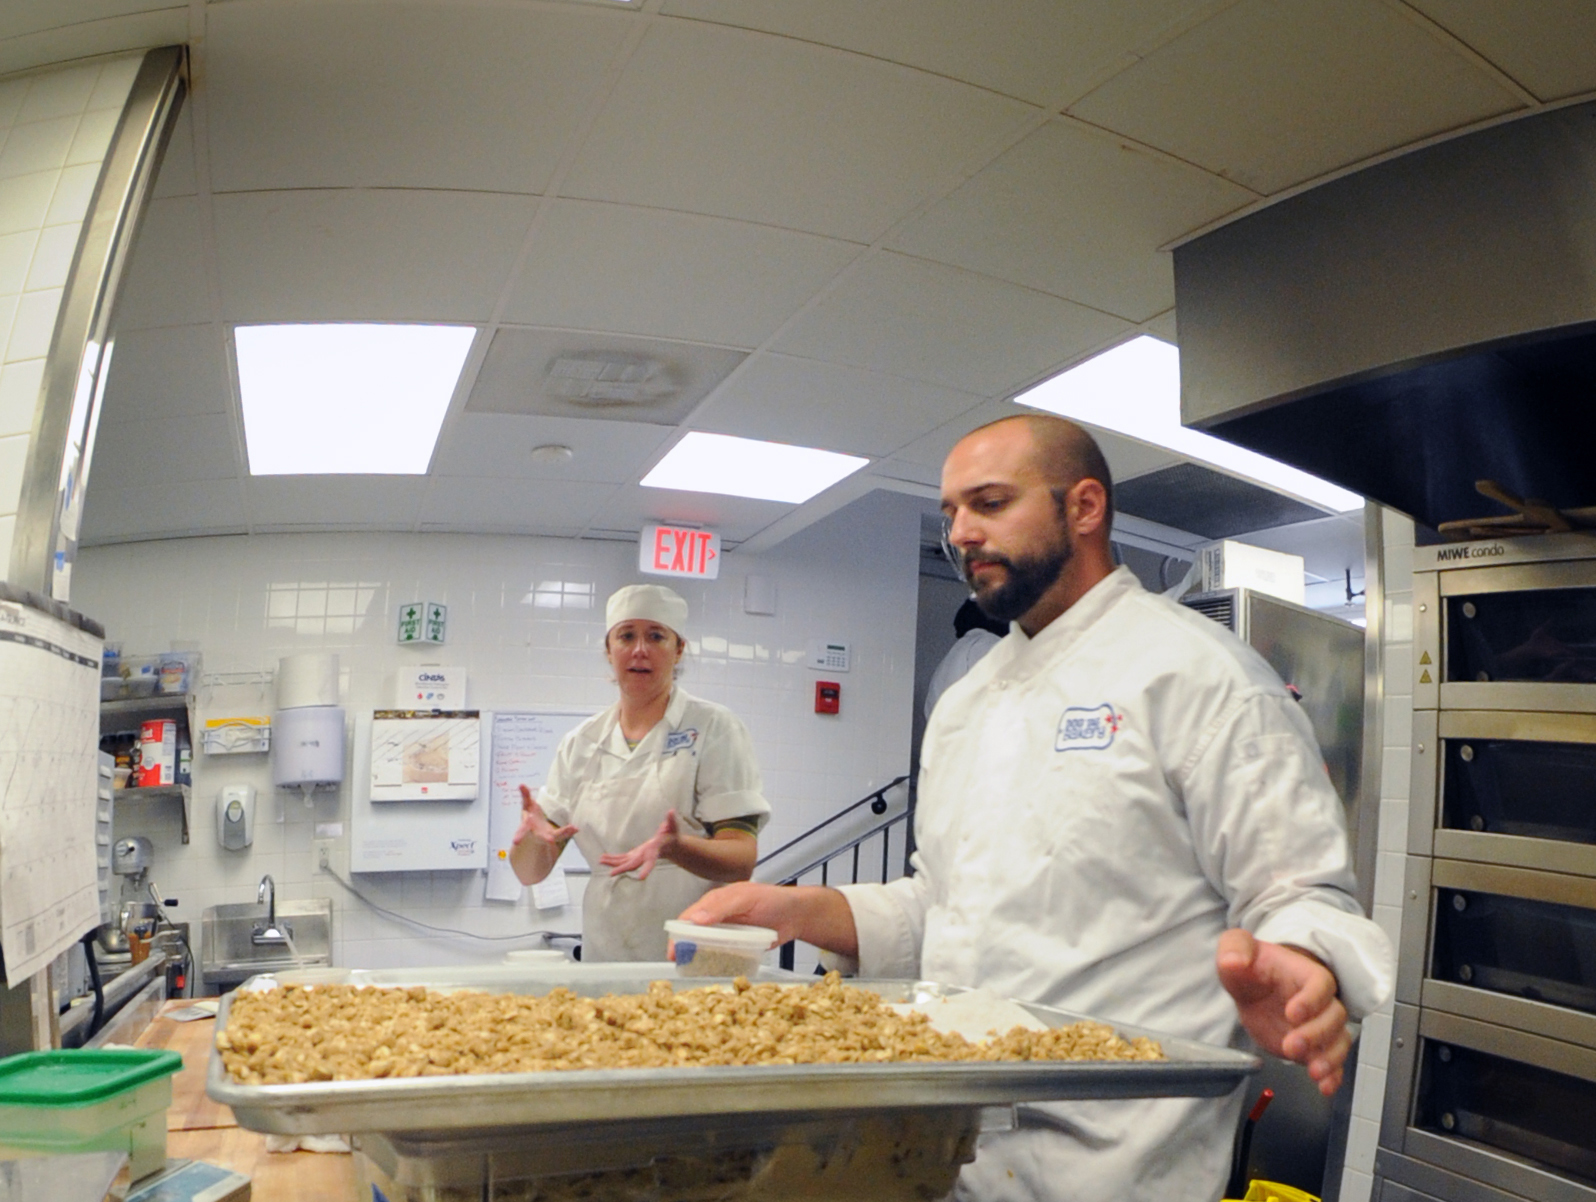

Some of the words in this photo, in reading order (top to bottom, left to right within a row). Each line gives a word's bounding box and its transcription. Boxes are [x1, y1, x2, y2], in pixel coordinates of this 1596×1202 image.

[654, 526, 712, 574] EXIT
[1437, 546, 1469, 562] MIWE
[1471, 542, 1505, 558] condo
[400, 618, 420, 627] FIRST
[404, 626, 416, 634] AID
